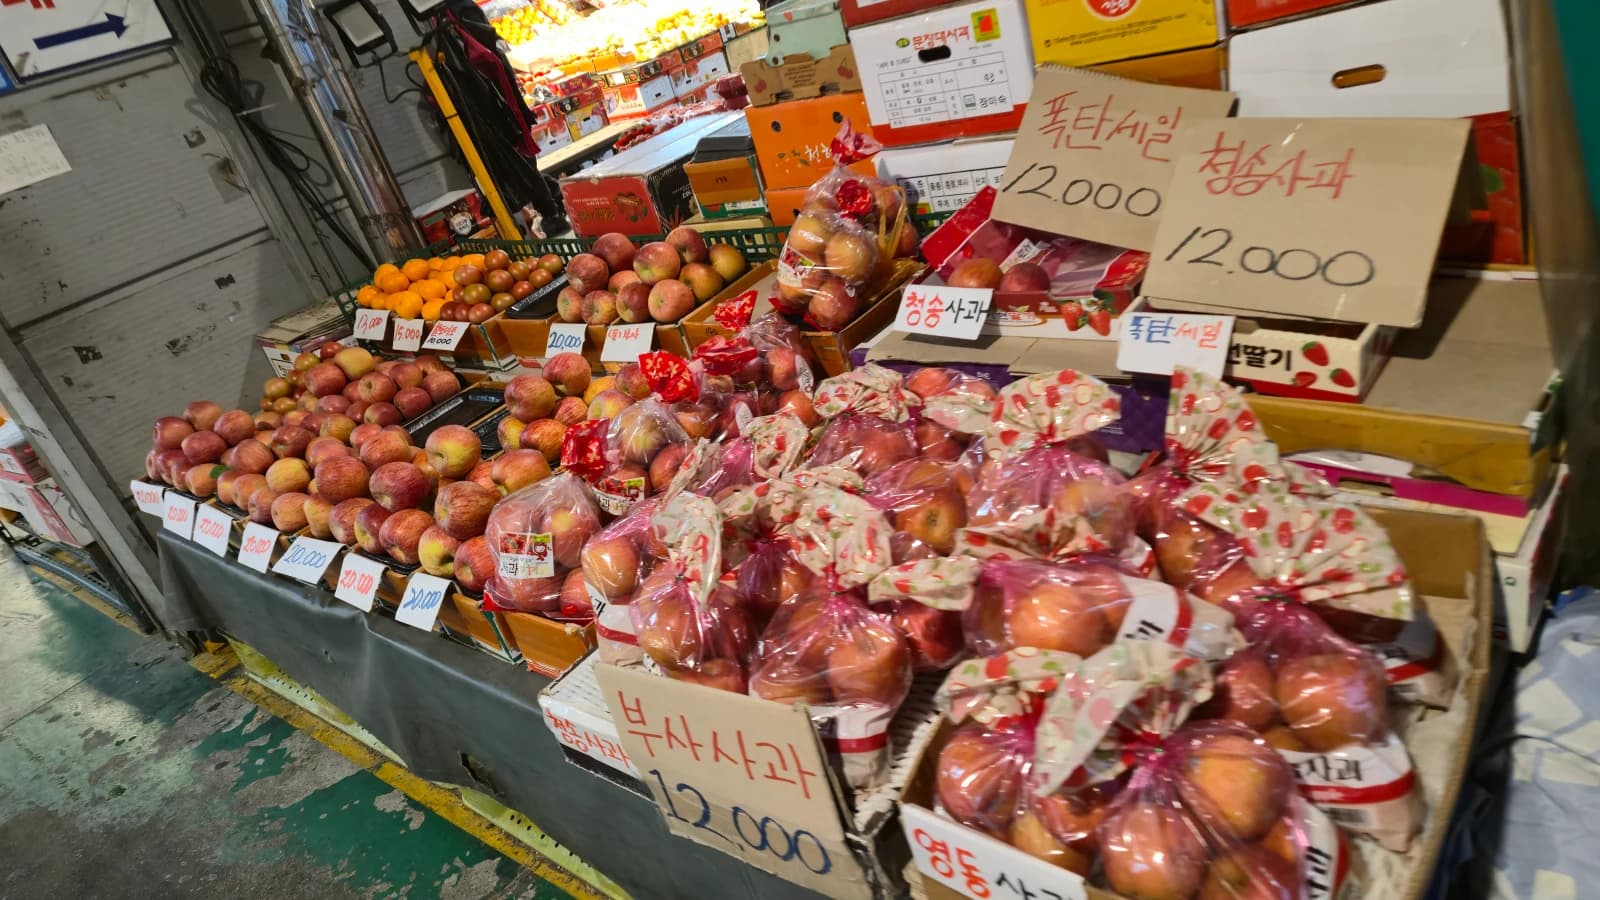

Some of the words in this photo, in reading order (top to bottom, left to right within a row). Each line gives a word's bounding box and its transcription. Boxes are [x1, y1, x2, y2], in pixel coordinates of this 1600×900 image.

[1002, 162, 1161, 217] 12.000
[1194, 131, 1355, 200] 청송사과
[1164, 226, 1375, 287] 12.000
[905, 291, 990, 328] 청송사과
[618, 690, 816, 800] 부사사과
